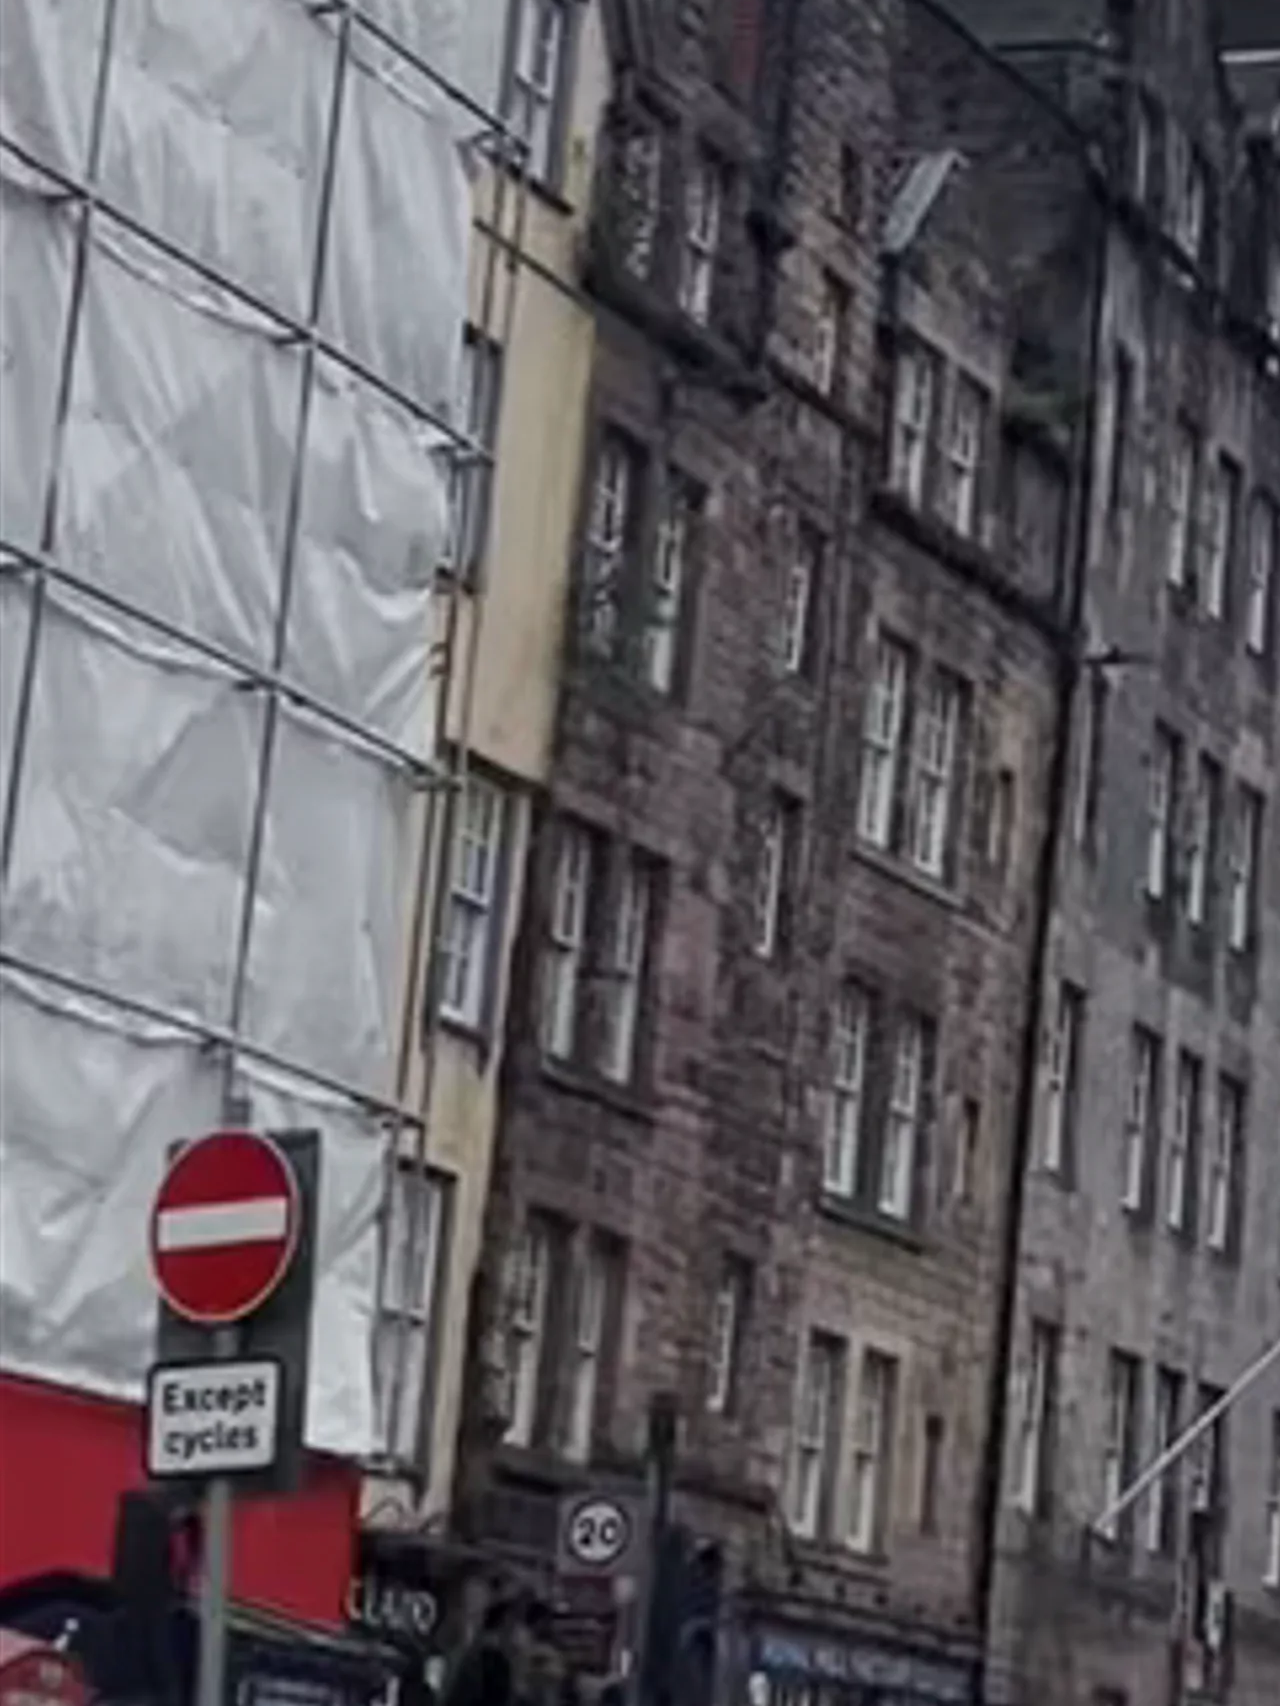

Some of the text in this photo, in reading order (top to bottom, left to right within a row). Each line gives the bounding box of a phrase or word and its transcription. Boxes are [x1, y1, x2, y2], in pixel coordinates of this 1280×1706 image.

[163, 1379, 266, 1416] Except
[164, 1420, 259, 1460] cycles
[577, 1516, 621, 1547] 20
